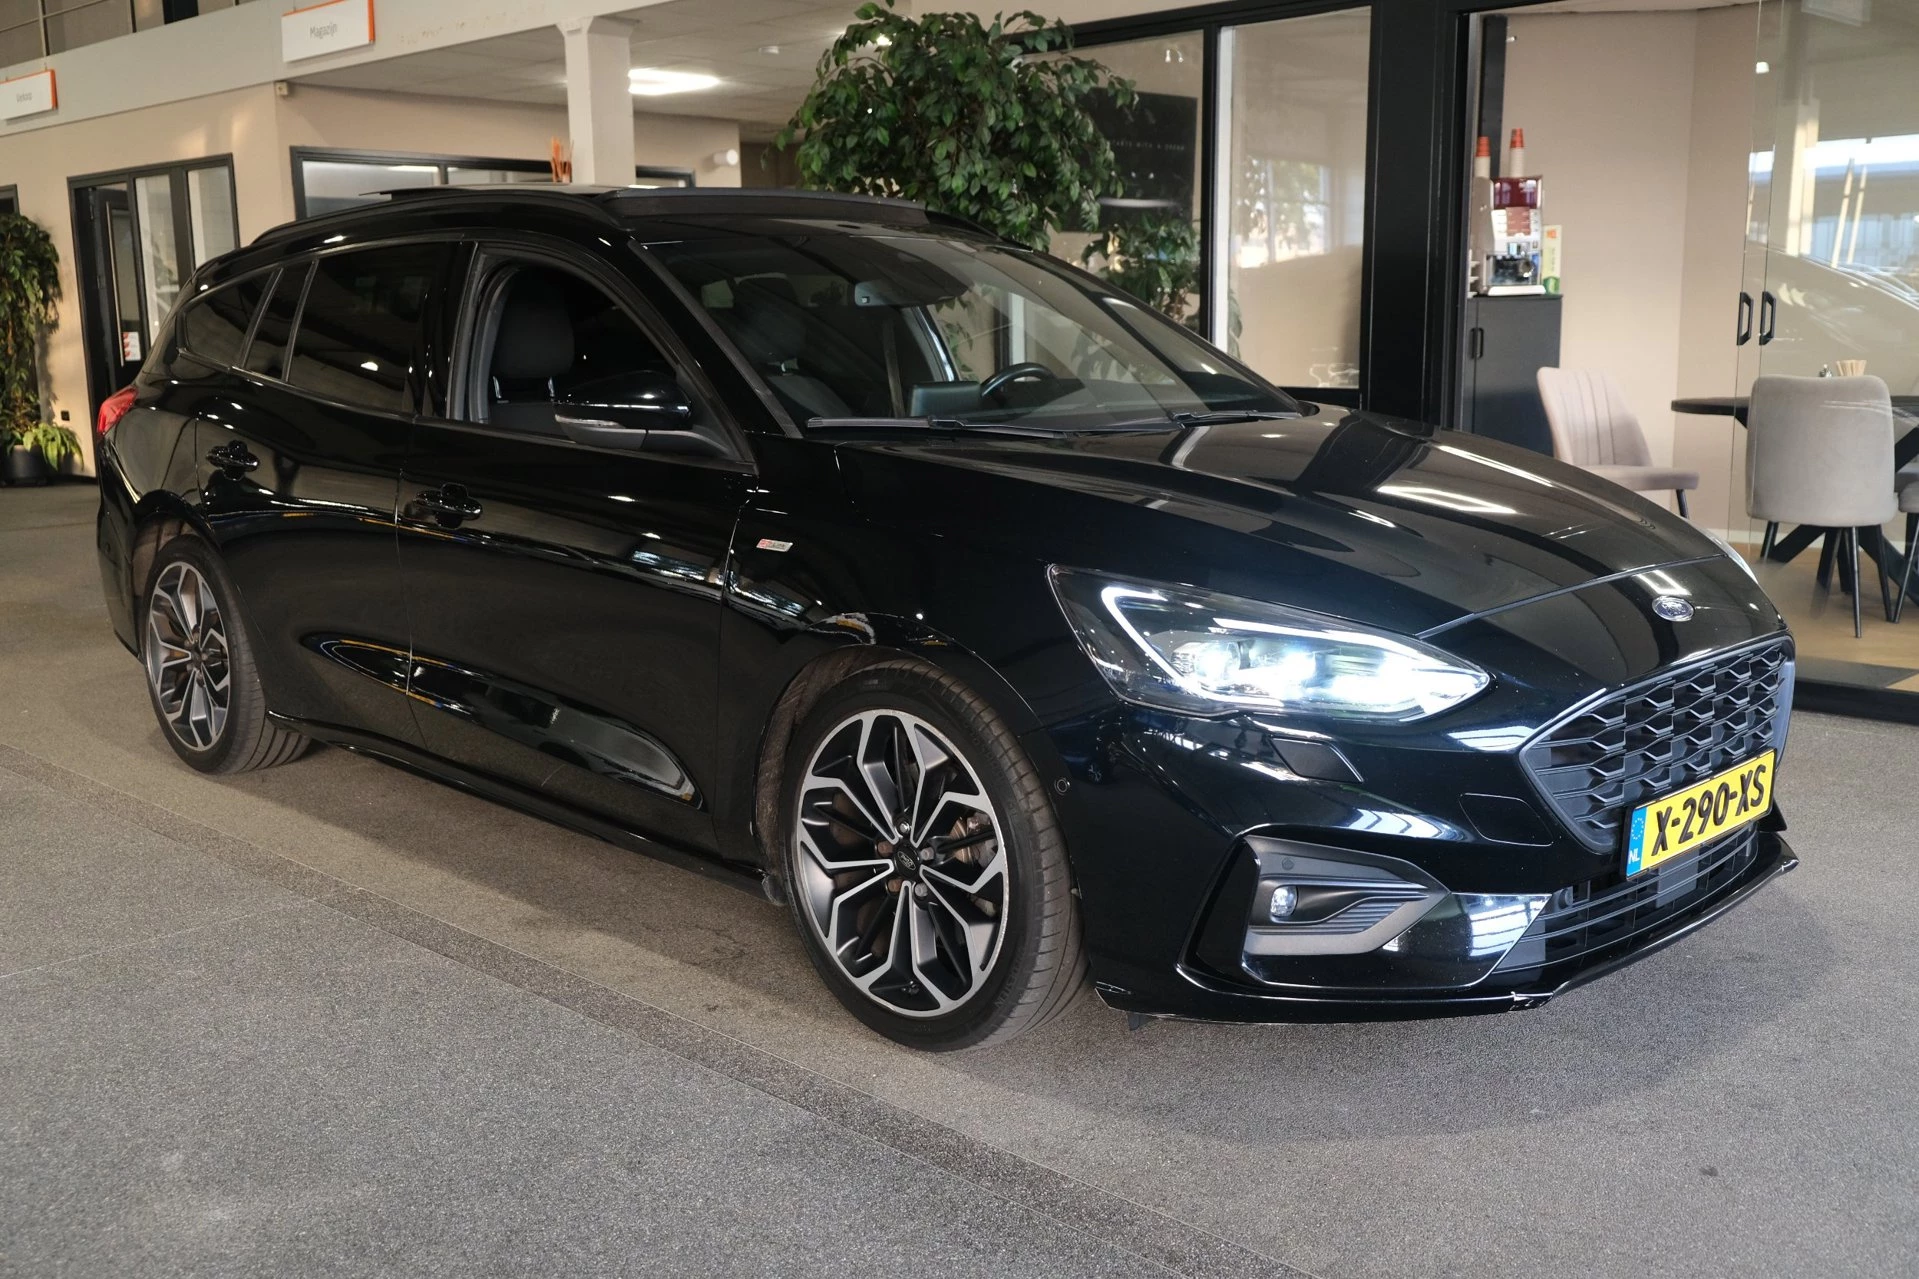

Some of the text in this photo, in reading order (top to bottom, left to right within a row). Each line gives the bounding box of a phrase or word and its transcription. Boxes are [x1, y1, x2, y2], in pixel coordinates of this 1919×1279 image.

[309, 22, 338, 39] Magazijn
[1651, 764, 1766, 856] X-290-XS
[1628, 848, 1640, 865] NL
